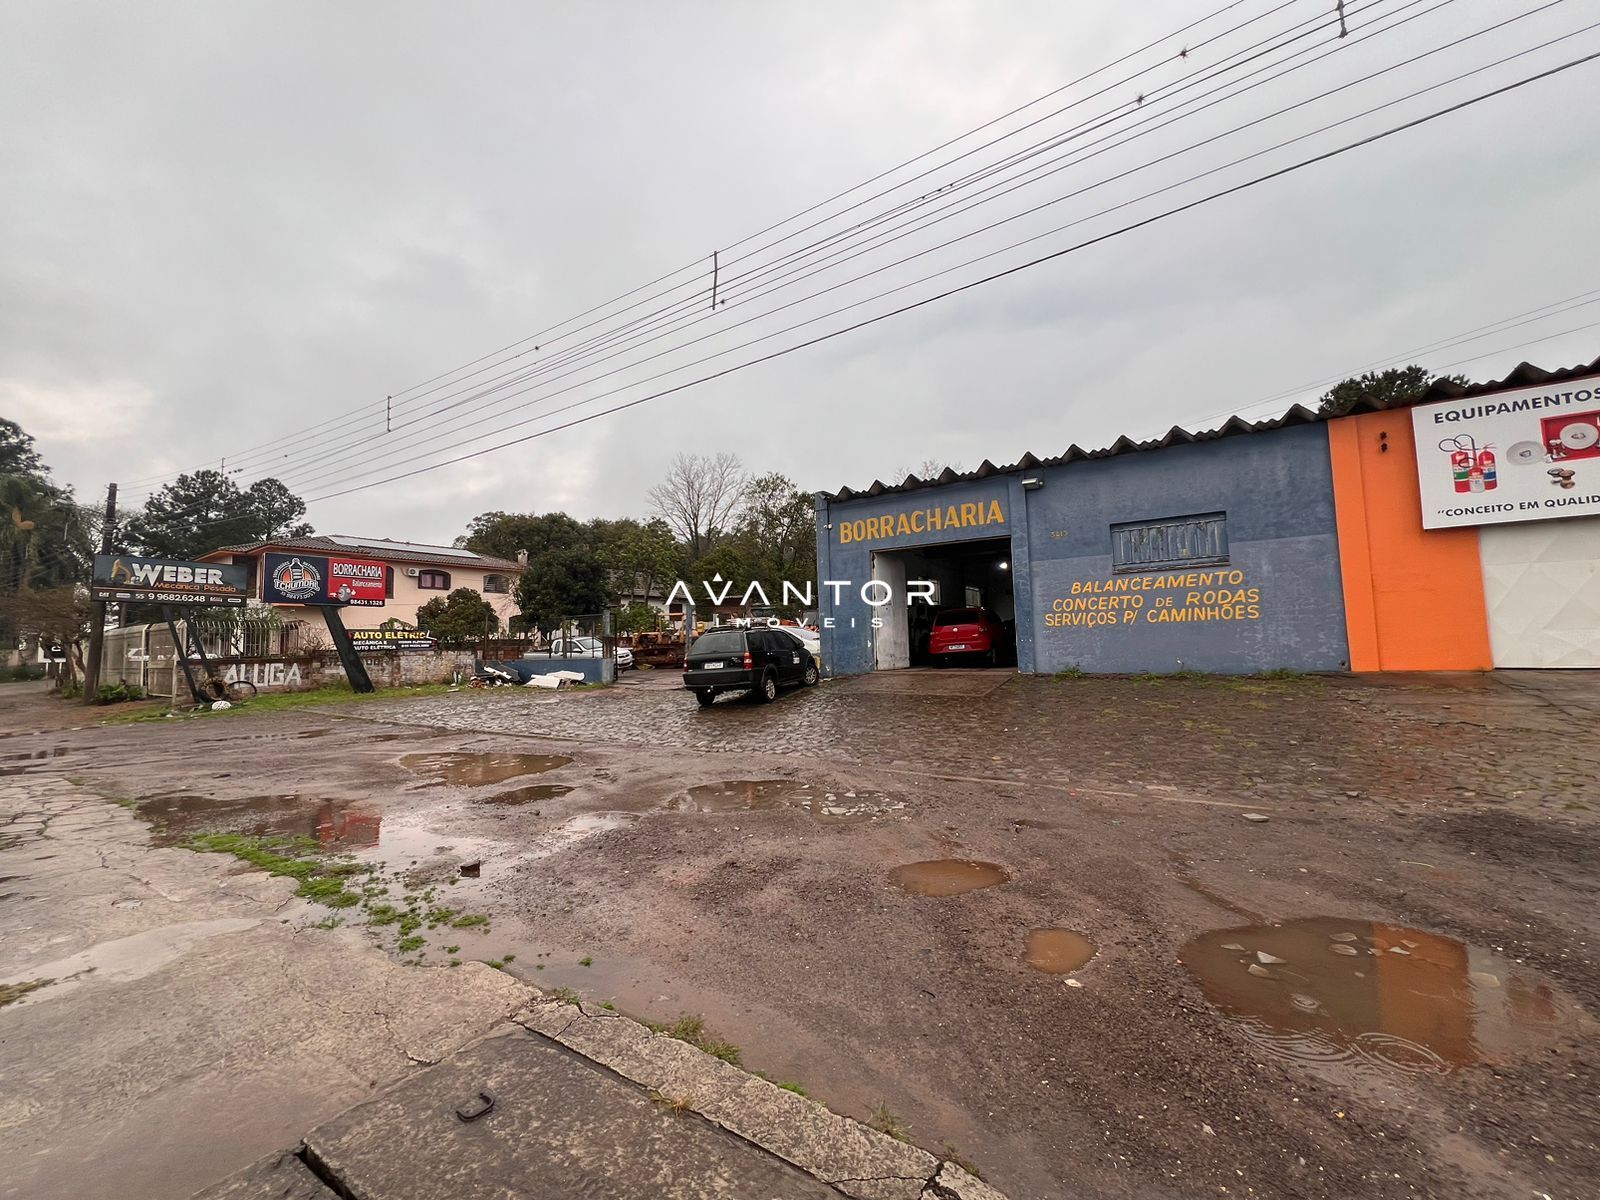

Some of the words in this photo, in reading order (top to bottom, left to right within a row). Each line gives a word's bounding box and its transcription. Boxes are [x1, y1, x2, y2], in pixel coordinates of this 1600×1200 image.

[1519, 501, 1539, 510] EM
[840, 500, 1004, 544] BORRACHARIA
[132, 563, 223, 586] WEBER
[333, 562, 382, 577] BORRACHARIA
[204, 584, 236, 593] Pesada
[1071, 570, 1243, 595] BALANCEAMENTO
[147, 592, 155, 600] 9
[156, 593, 206, 602] 9682.6248
[1053, 595, 1144, 613] CONCERTO
[1155, 597, 1173, 607] DE
[1186, 588, 1260, 606] RODAS
[1045, 611, 1117, 628] SERVIÇOS
[1123, 610, 1138, 625] P/
[1147, 605, 1260, 624] CAMINHÕES
[353, 631, 382, 640] AUTO
[225, 662, 301, 688] ALUGA
